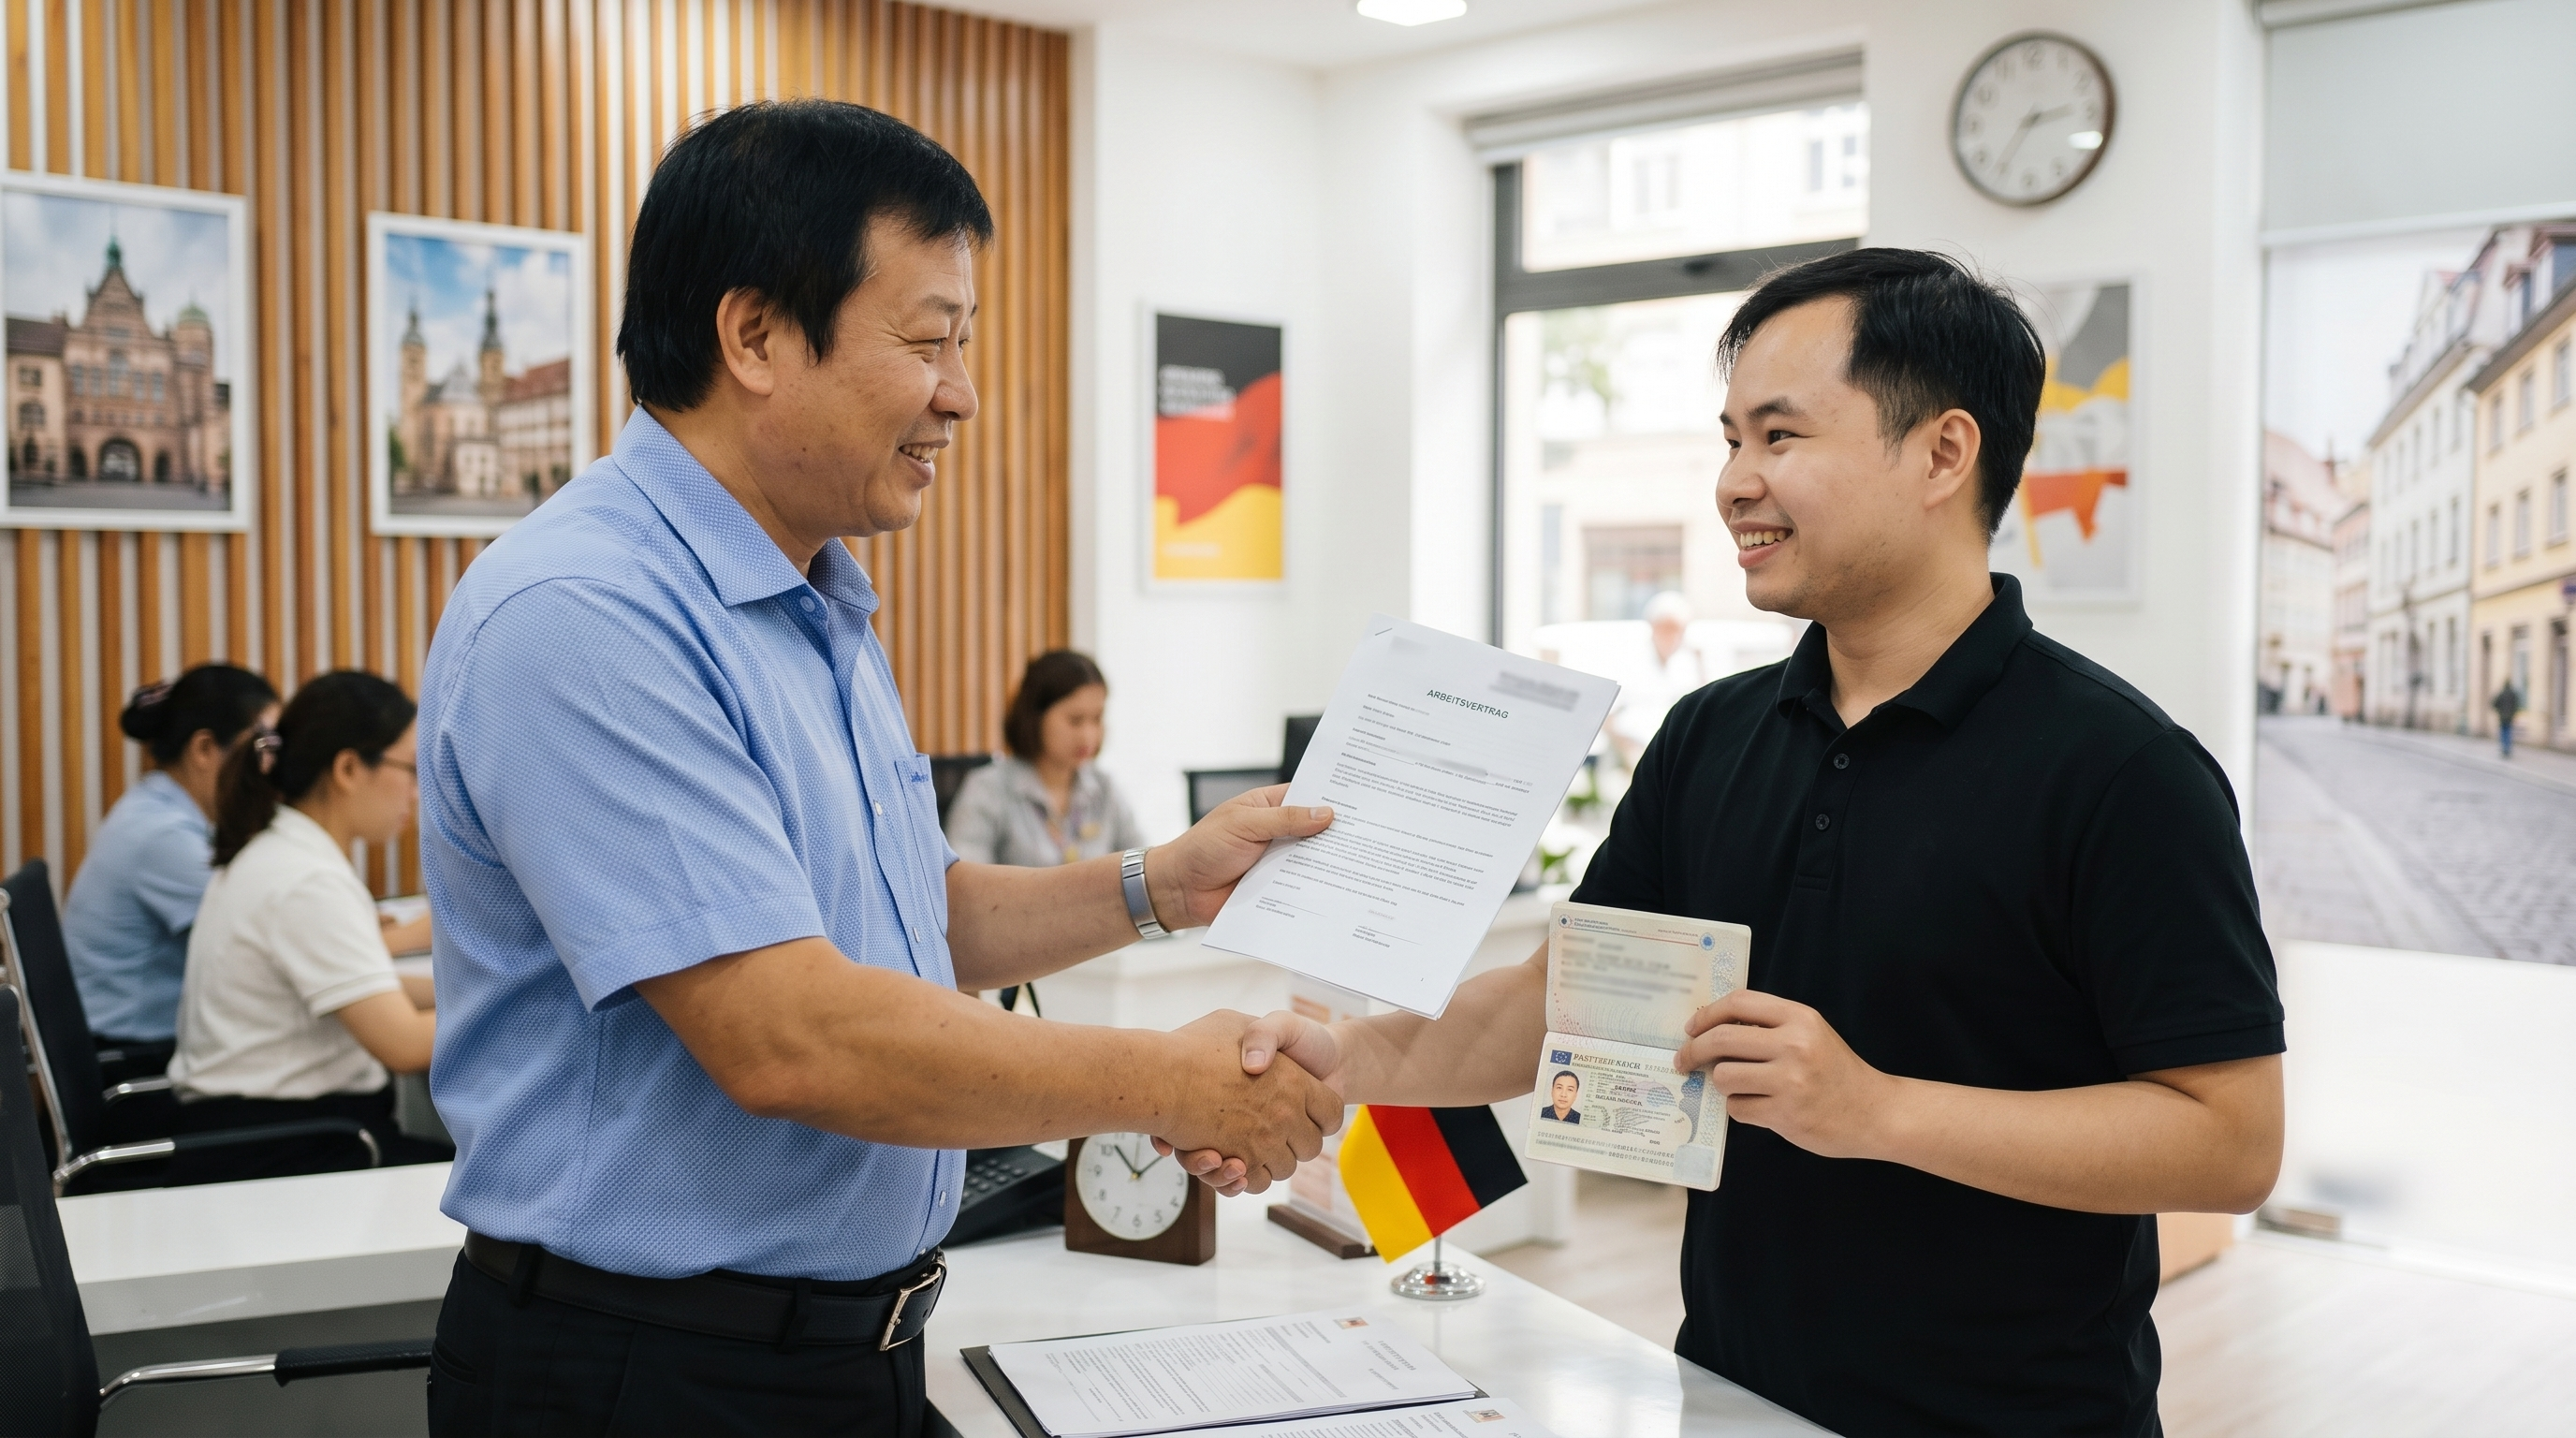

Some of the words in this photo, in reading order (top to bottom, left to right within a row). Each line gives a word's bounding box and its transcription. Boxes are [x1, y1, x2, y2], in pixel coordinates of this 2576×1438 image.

[1427, 689, 1510, 719] ARBEITSVERTRAG
[1101, 1143, 1114, 1156] 10
[1177, 1172, 1185, 1186] 3
[1099, 1189, 1106, 1201] 8
[1169, 1196, 1179, 1209] 4
[1132, 1214, 1142, 1228] 6
[1154, 1209, 1163, 1224] 5
